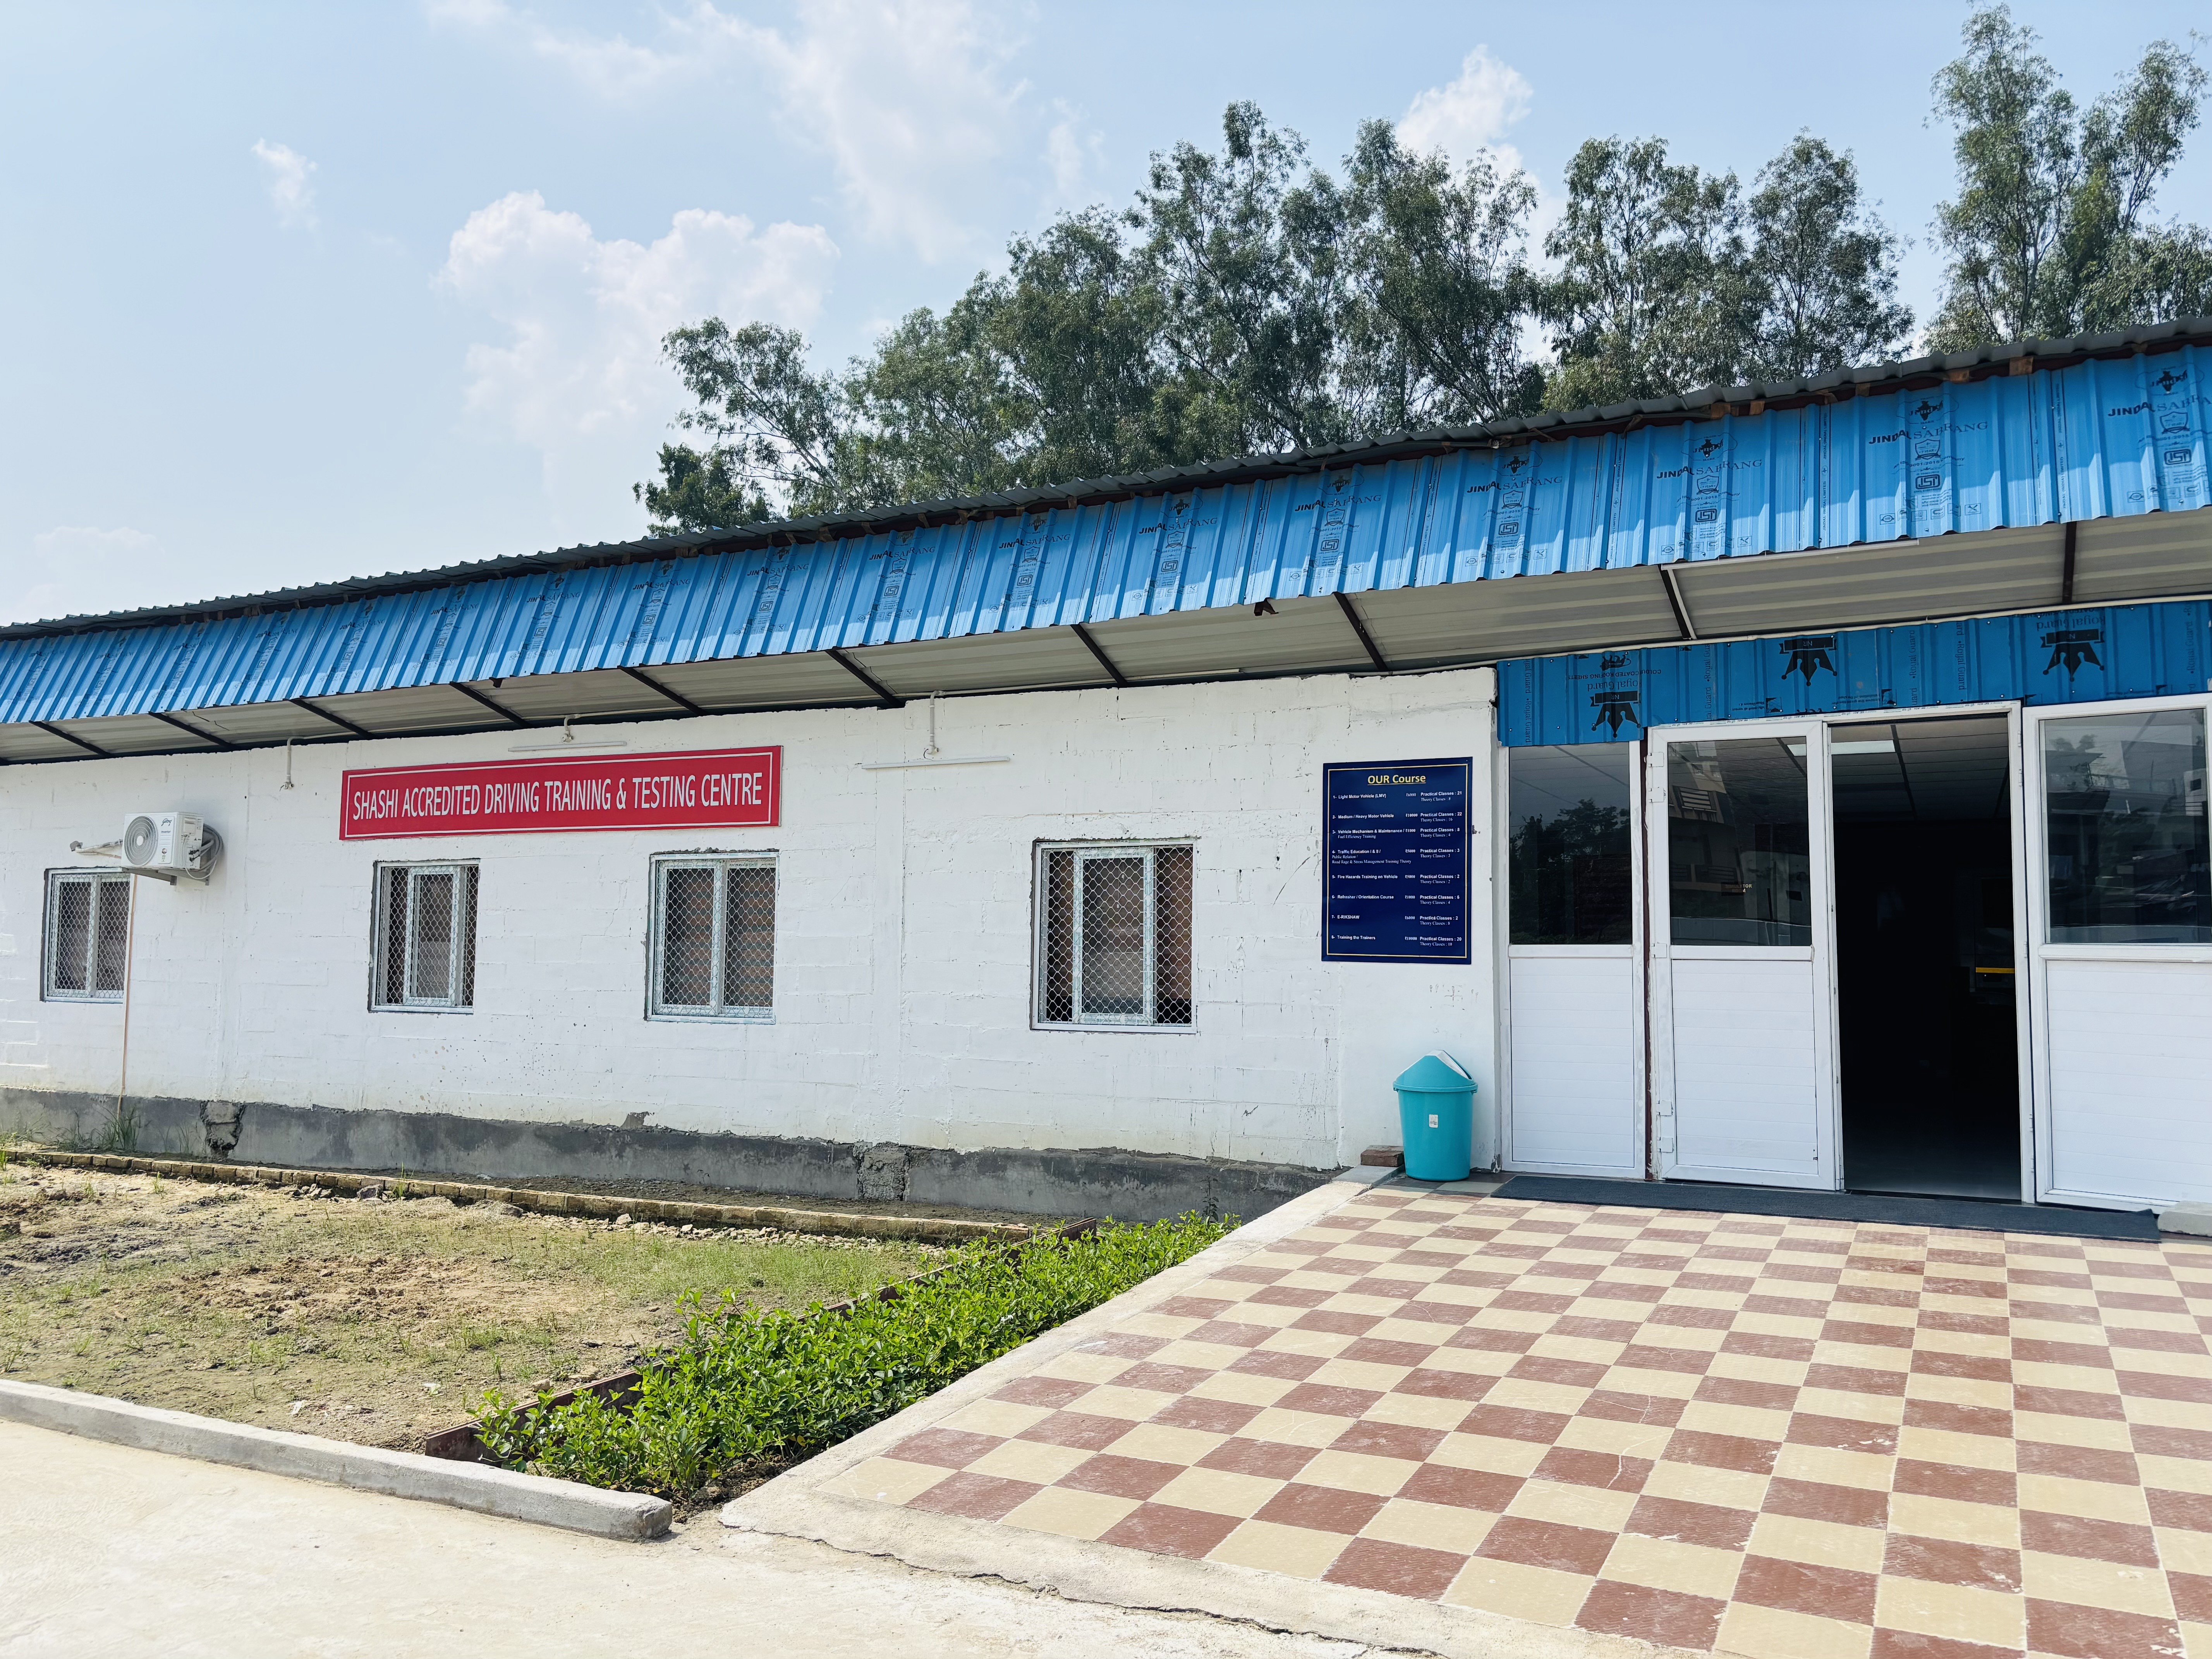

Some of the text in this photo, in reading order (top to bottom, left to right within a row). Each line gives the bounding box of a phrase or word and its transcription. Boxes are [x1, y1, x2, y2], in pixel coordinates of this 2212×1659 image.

[1869, 429, 1912, 444] JINDAL
[1704, 659, 1713, 680] Royal
[1587, 682, 1614, 692] Guard
[1368, 775, 1426, 784] OUR Course
[353, 773, 762, 820] SHASHI ACCREDITED DRIVING TRAINING & TESTING CENTRE
